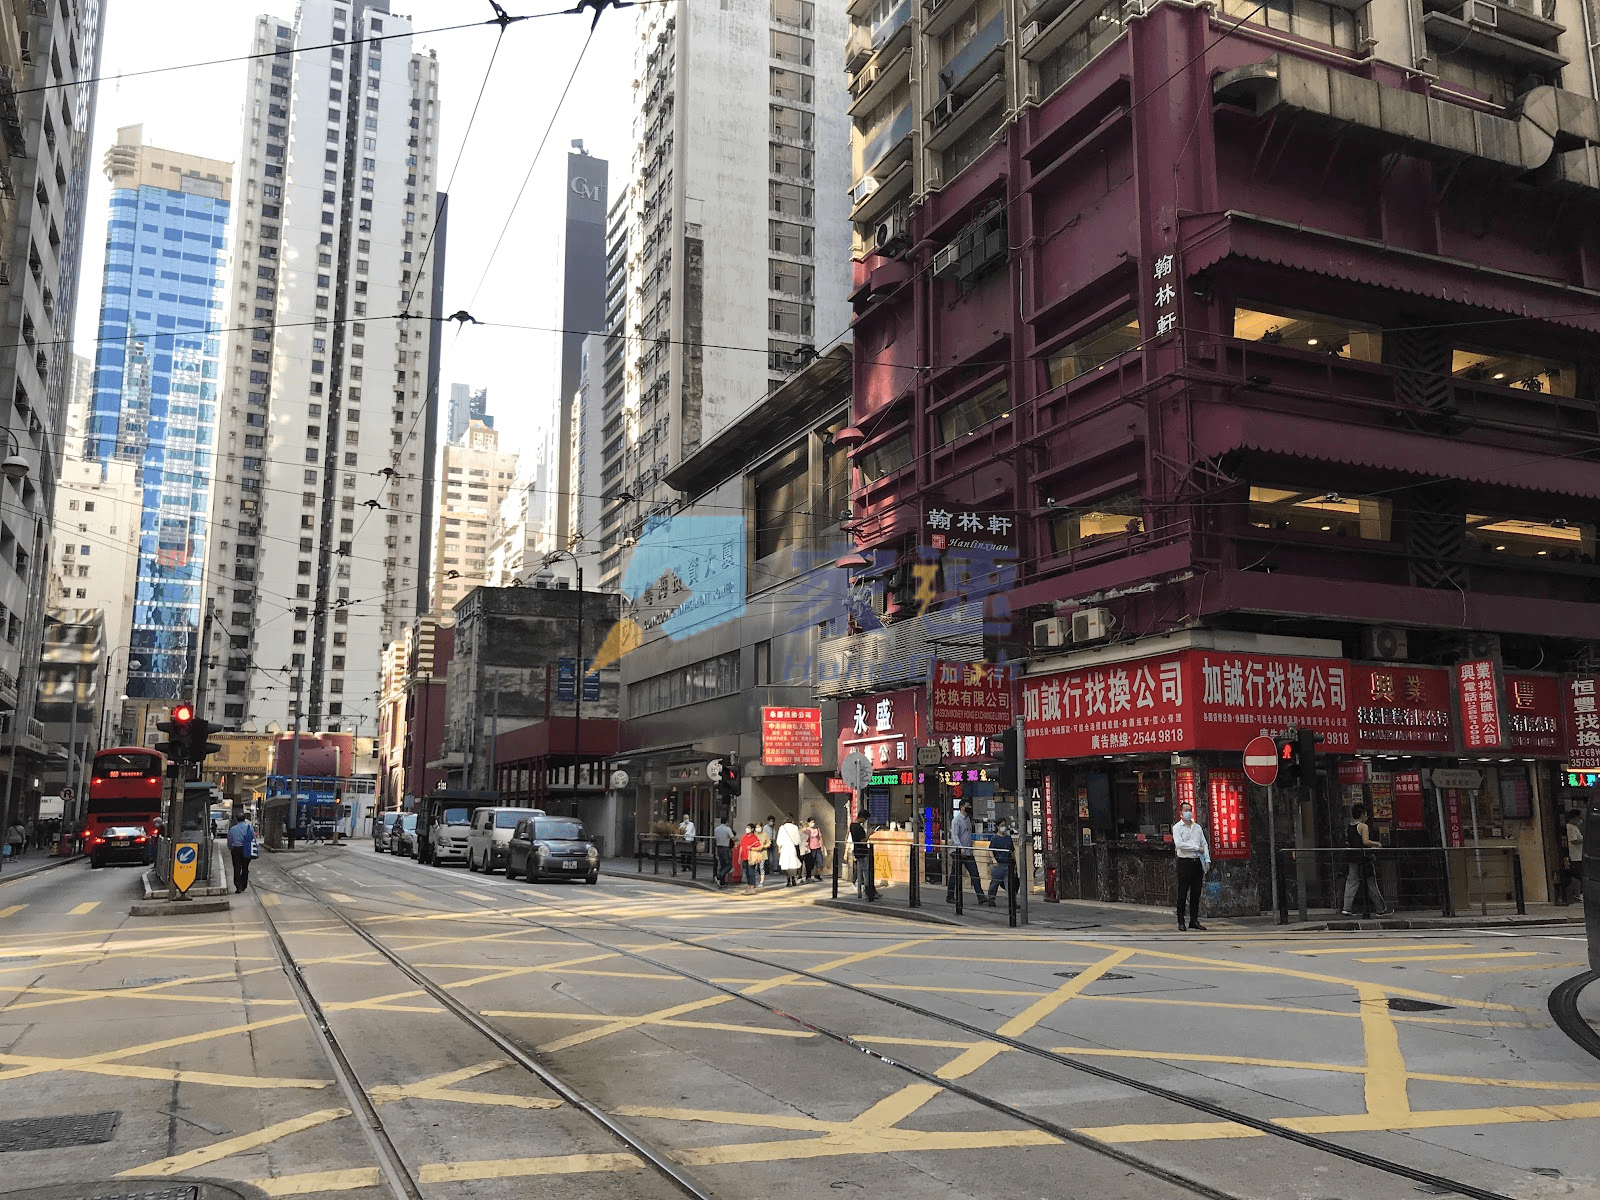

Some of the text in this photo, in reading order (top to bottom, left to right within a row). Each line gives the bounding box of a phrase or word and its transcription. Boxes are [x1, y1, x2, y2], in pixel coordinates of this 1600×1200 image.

[1153, 254, 1177, 337] 翰林軒
[926, 508, 1013, 536] 翰林軒
[947, 538, 1009, 552] Hanlinxuan
[940, 664, 1004, 689] 加誠行
[1202, 657, 1346, 712] 加誠行找換公司
[1461, 662, 1491, 682] 興業
[935, 688, 1009, 709] 找換有限公司
[1022, 661, 1183, 722] 加誠行找換公司
[853, 698, 893, 734] 永盛
[1571, 680, 1600, 747] 恒豐找換
[1133, 731, 1156, 745] 2544
[1158, 728, 1183, 743] 9818
[1327, 732, 1349, 745] 9818
